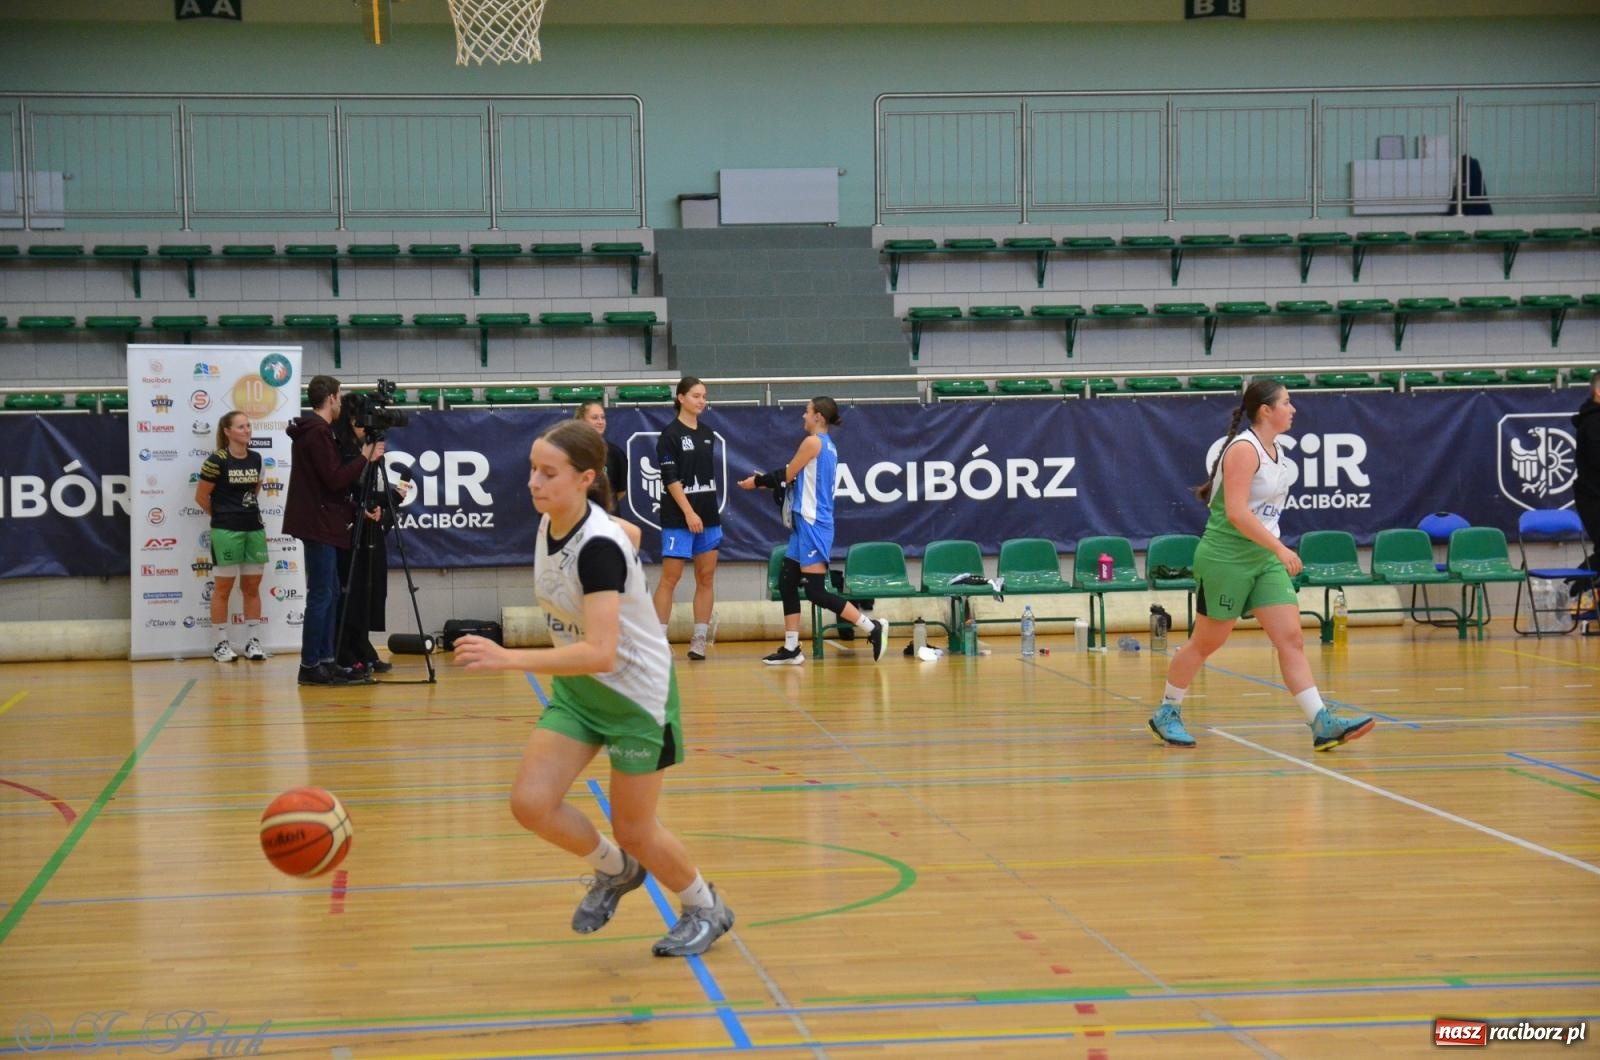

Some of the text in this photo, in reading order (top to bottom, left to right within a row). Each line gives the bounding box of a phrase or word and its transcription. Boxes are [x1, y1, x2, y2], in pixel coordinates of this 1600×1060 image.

[180, 0, 236, 16] A A
[245, 380, 265, 402] 10
[377, 450, 494, 506] SiR
[833, 444, 1078, 503] ACIBÓRZ
[1282, 490, 1371, 509] ACIBÓRZ
